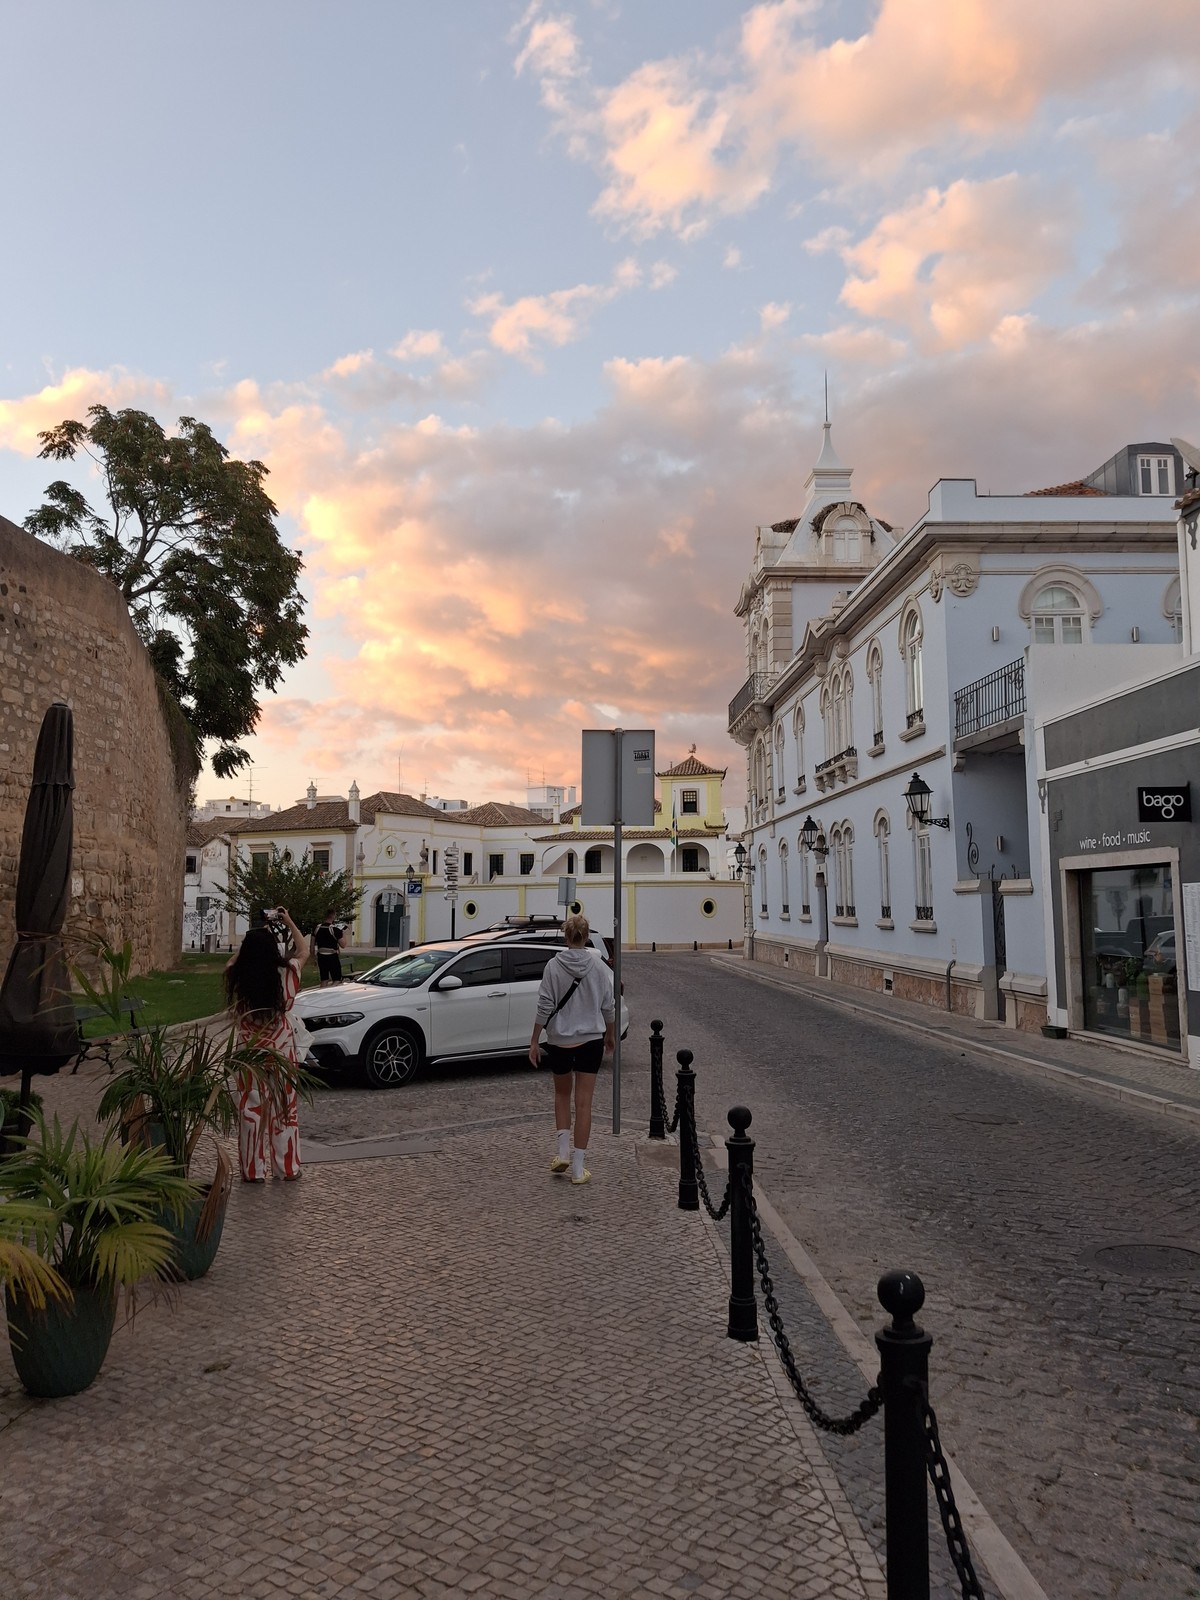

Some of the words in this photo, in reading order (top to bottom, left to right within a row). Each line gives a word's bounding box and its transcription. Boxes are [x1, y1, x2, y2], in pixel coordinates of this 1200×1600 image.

[1143, 791, 1184, 818] bago
[1080, 837, 1096, 849] wine
[1102, 831, 1120, 847] food
[1127, 829, 1151, 844] music
[409, 884, 415, 892] P
